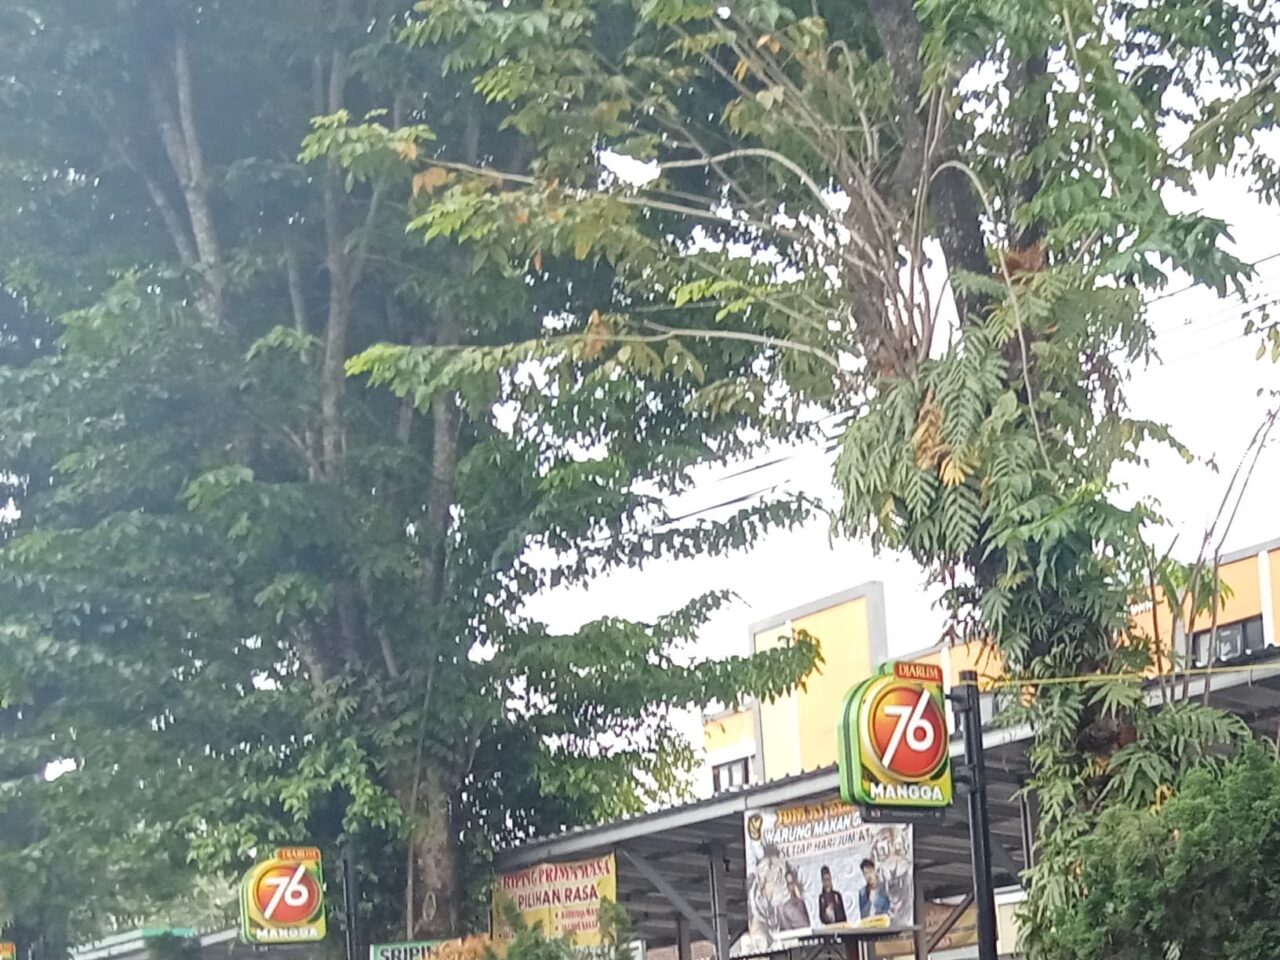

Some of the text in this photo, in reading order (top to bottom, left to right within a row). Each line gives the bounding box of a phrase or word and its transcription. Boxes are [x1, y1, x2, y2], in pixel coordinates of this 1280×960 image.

[899, 663, 938, 679] DJARUM
[881, 687, 935, 769] 76
[870, 783, 943, 800] MANGGA
[764, 823, 811, 844] WARUNG
[813, 813, 851, 835] MAKAN
[263, 864, 309, 920] 76
[518, 883, 599, 909] PILIHAN RASA
